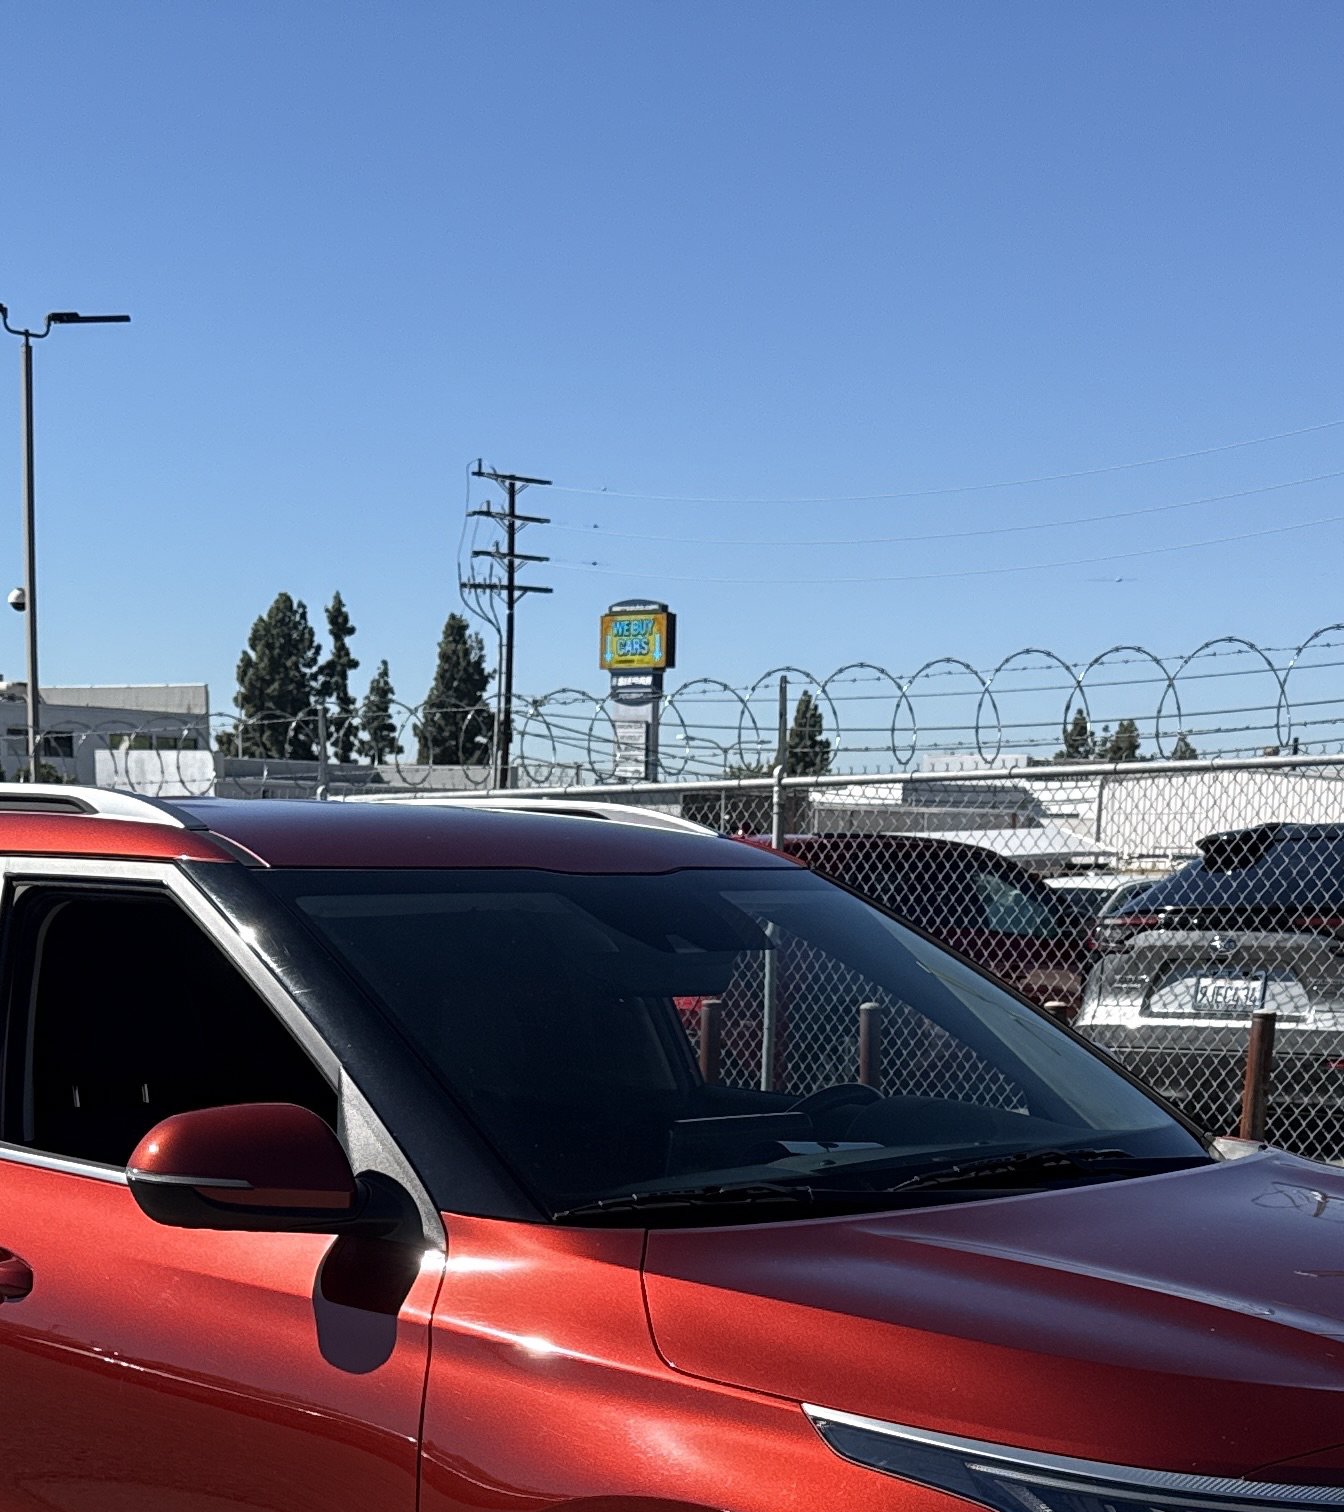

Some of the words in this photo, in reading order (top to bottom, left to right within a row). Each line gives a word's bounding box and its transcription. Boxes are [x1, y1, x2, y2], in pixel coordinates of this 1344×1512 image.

[612, 620, 631, 637] WE
[632, 619, 655, 637] BUY
[616, 638, 650, 656] CARS
